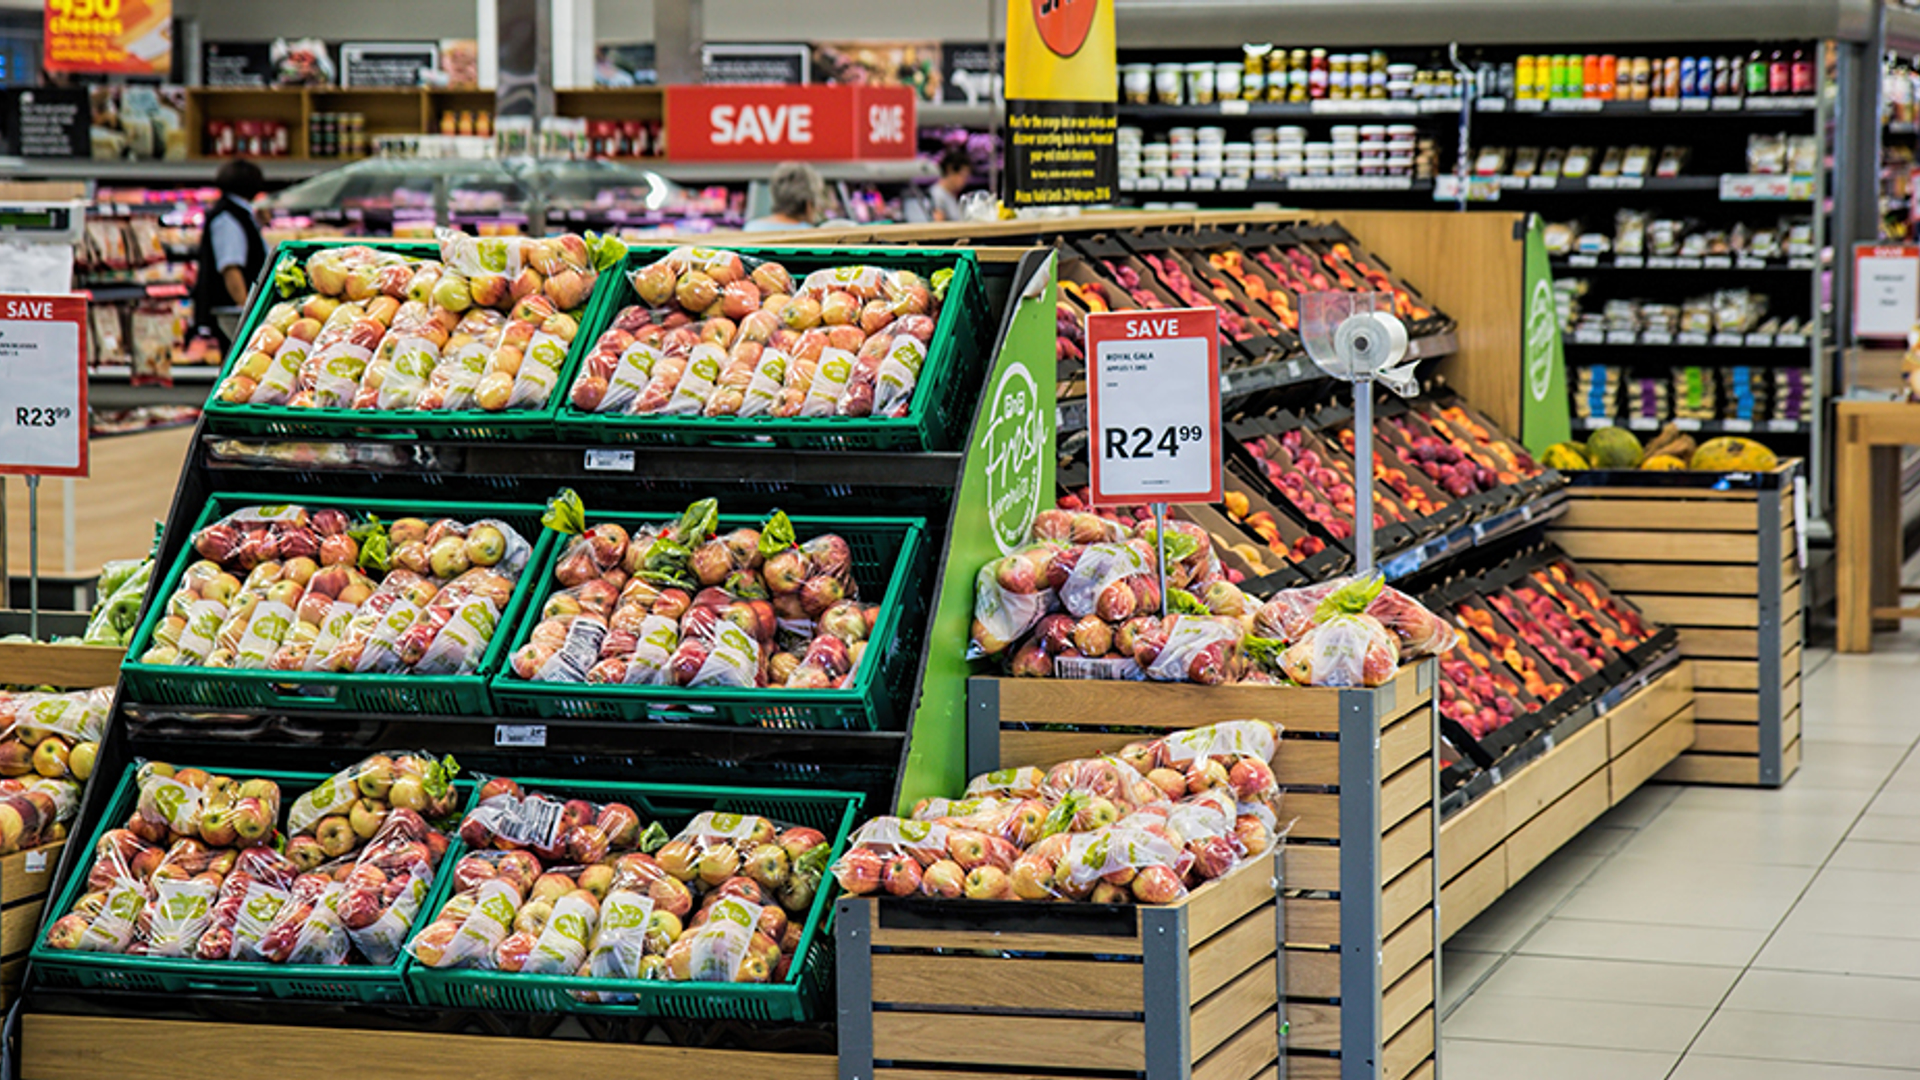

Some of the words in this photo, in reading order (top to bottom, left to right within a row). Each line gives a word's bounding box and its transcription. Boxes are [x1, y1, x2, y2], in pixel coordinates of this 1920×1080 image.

[710, 104, 813, 144] SAVE
[868, 104, 904, 144] SAVE
[6, 301, 54, 319] SAVE
[1126, 318, 1179, 337] SAVE
